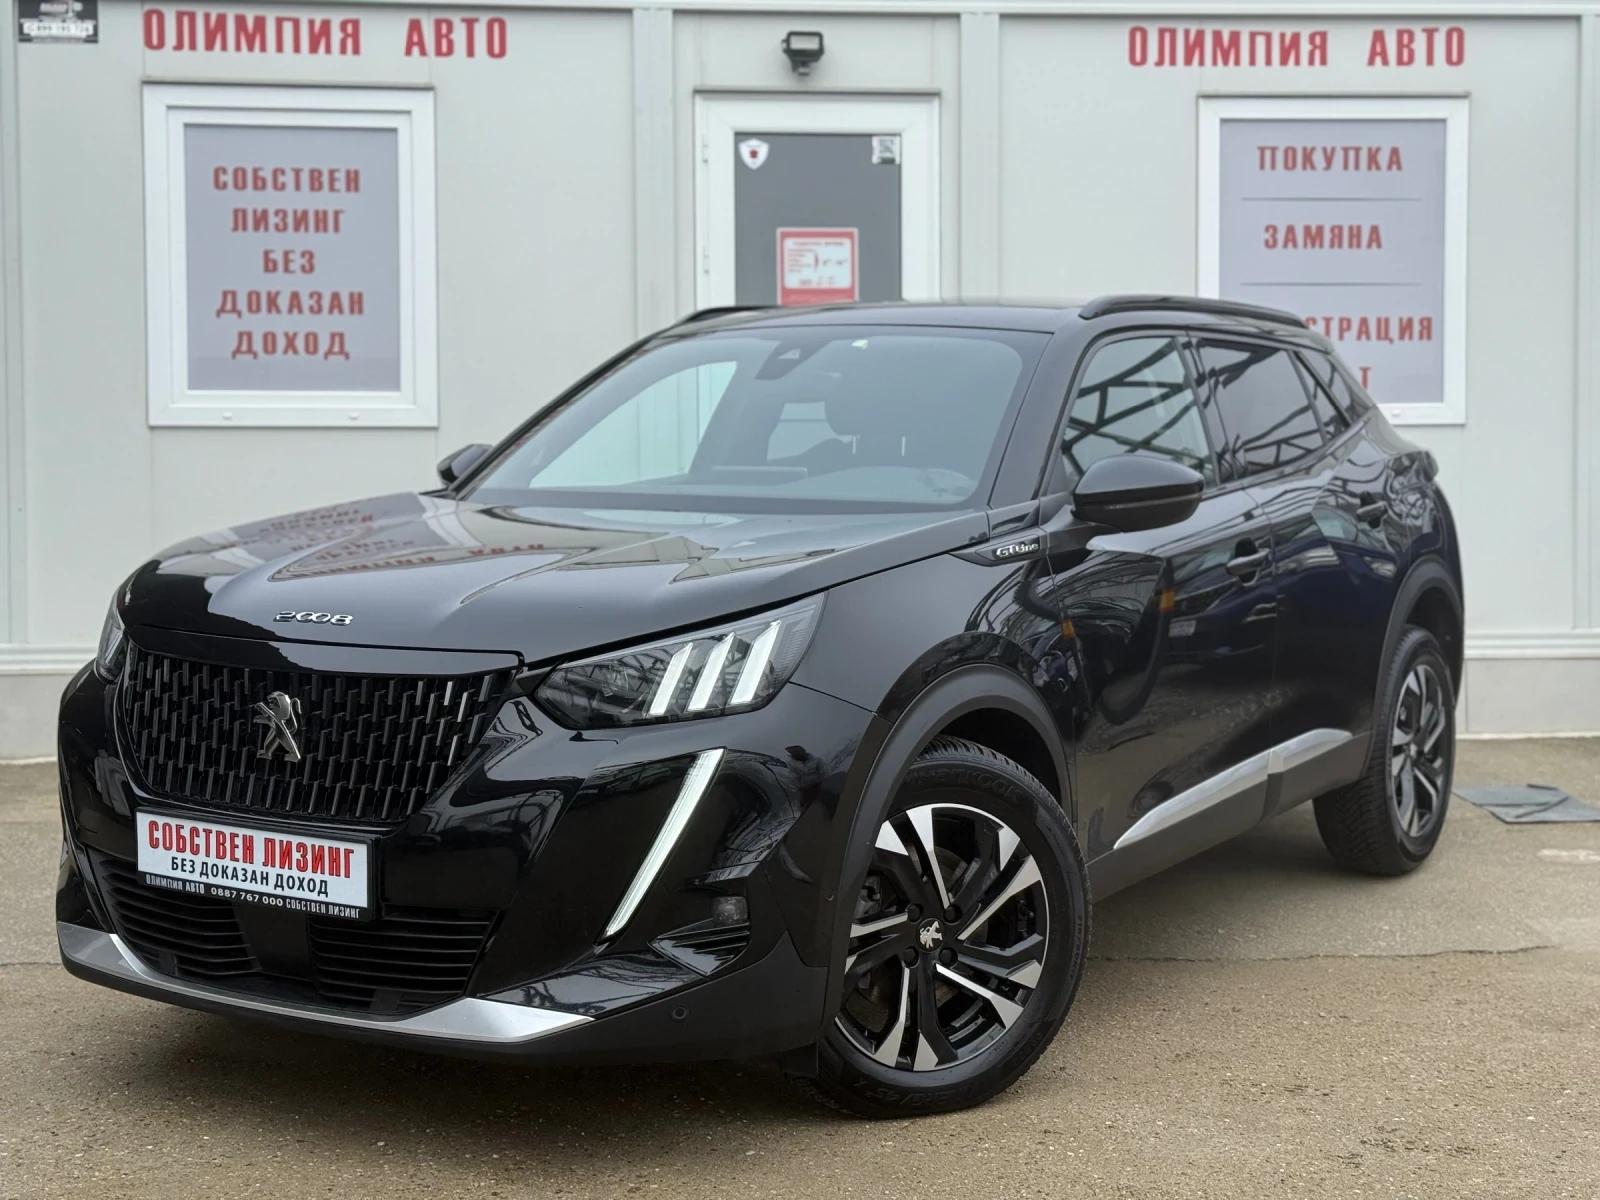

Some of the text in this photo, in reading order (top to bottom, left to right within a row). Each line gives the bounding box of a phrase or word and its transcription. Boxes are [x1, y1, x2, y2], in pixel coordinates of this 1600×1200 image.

[142, 8, 362, 56] ОЛИМПИЯ
[403, 16, 508, 60] АВТО
[1127, 25, 1466, 67] ОЛИМПИЯ АВТО
[1256, 146, 1403, 171] ПОКУПКА
[213, 166, 361, 193] СОБСТВЕН
[231, 208, 345, 234] ЛИЗИНГ
[1263, 224, 1383, 249] ЗАМЯНА
[262, 249, 316, 275] БЕЗ
[216, 290, 364, 319] ДОКАЗАН
[231, 331, 350, 360] ДОХОД
[274, 611, 353, 626] 2008
[148, 820, 355, 879] СОБСТВЕН ЛИЗИНГ
[171, 856, 328, 898] БЕЗ ДОКАЗАН ДОХОД
[145, 874, 361, 919] ОЛИМПИЯ АВТО 0887 767 000 СОБСТВЕН ЛИЗИНГ
